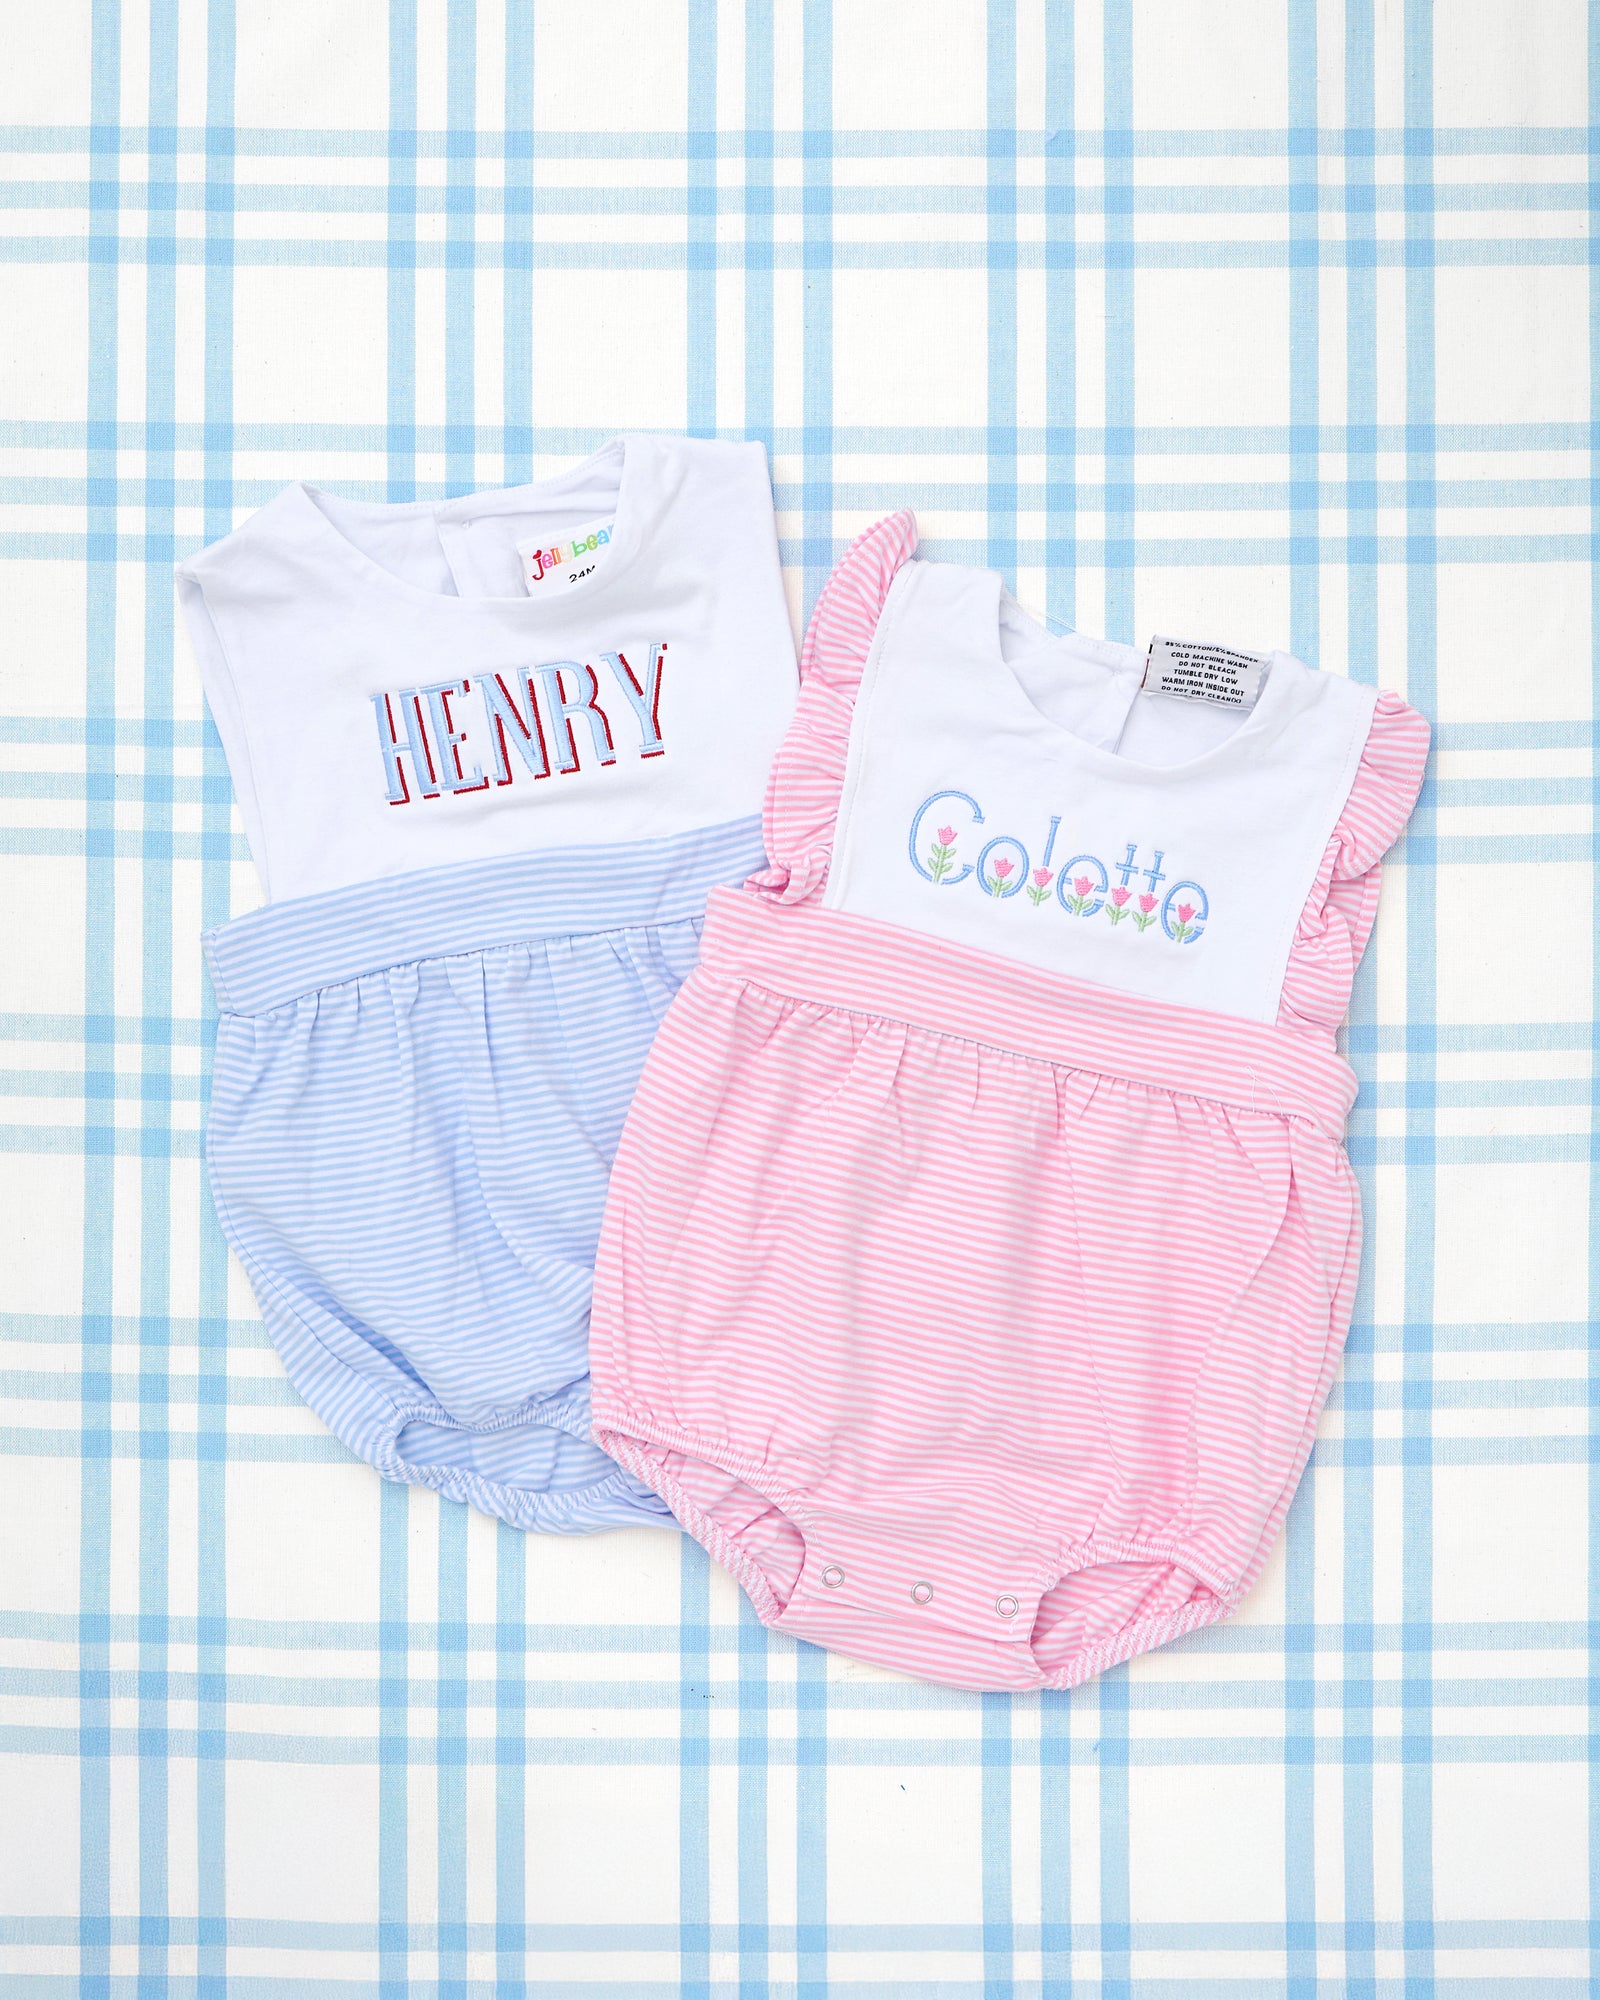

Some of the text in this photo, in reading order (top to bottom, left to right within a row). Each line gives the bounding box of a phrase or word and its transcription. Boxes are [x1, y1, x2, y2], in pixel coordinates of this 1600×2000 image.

[1193, 654, 1224, 663] MACHINE
[1227, 660, 1248, 669] WASH
[1208, 665, 1236, 675] BLEACH
[1174, 669, 1202, 677] TUMBLE
[1221, 676, 1238, 685] LOW
[1162, 677, 1185, 685] WARM
[1206, 682, 1228, 693] INSIDE
[1231, 687, 1245, 696] OUT
[370, 643, 667, 805] HENRY
[909, 791, 1209, 944] Colette
